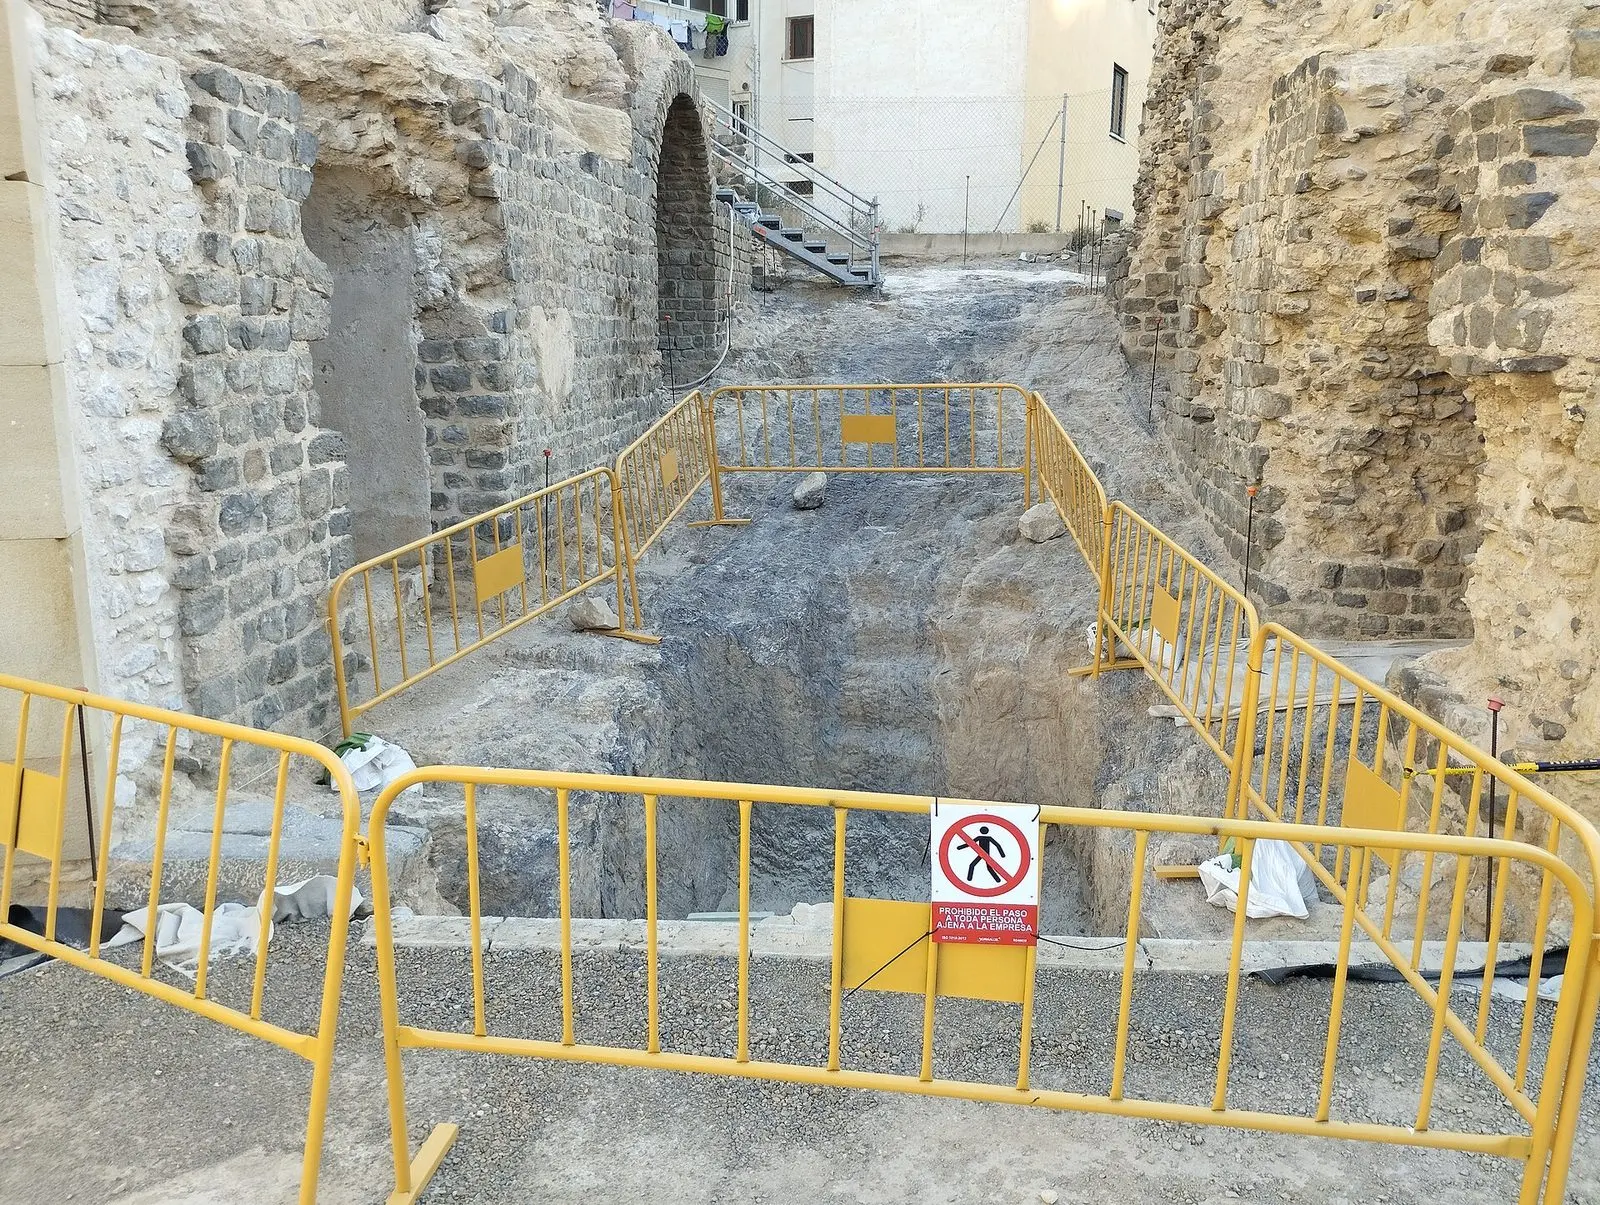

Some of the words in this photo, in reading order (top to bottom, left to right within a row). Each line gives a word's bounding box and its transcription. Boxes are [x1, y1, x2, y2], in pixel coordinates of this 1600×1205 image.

[939, 907, 987, 916] PROHIBIDO
[1003, 909, 1028, 918] PASO
[955, 915, 979, 923] TODA
[980, 916, 1023, 924] PERSONA
[936, 921, 965, 929] AJENA
[990, 924, 1032, 932] EMPRESA
